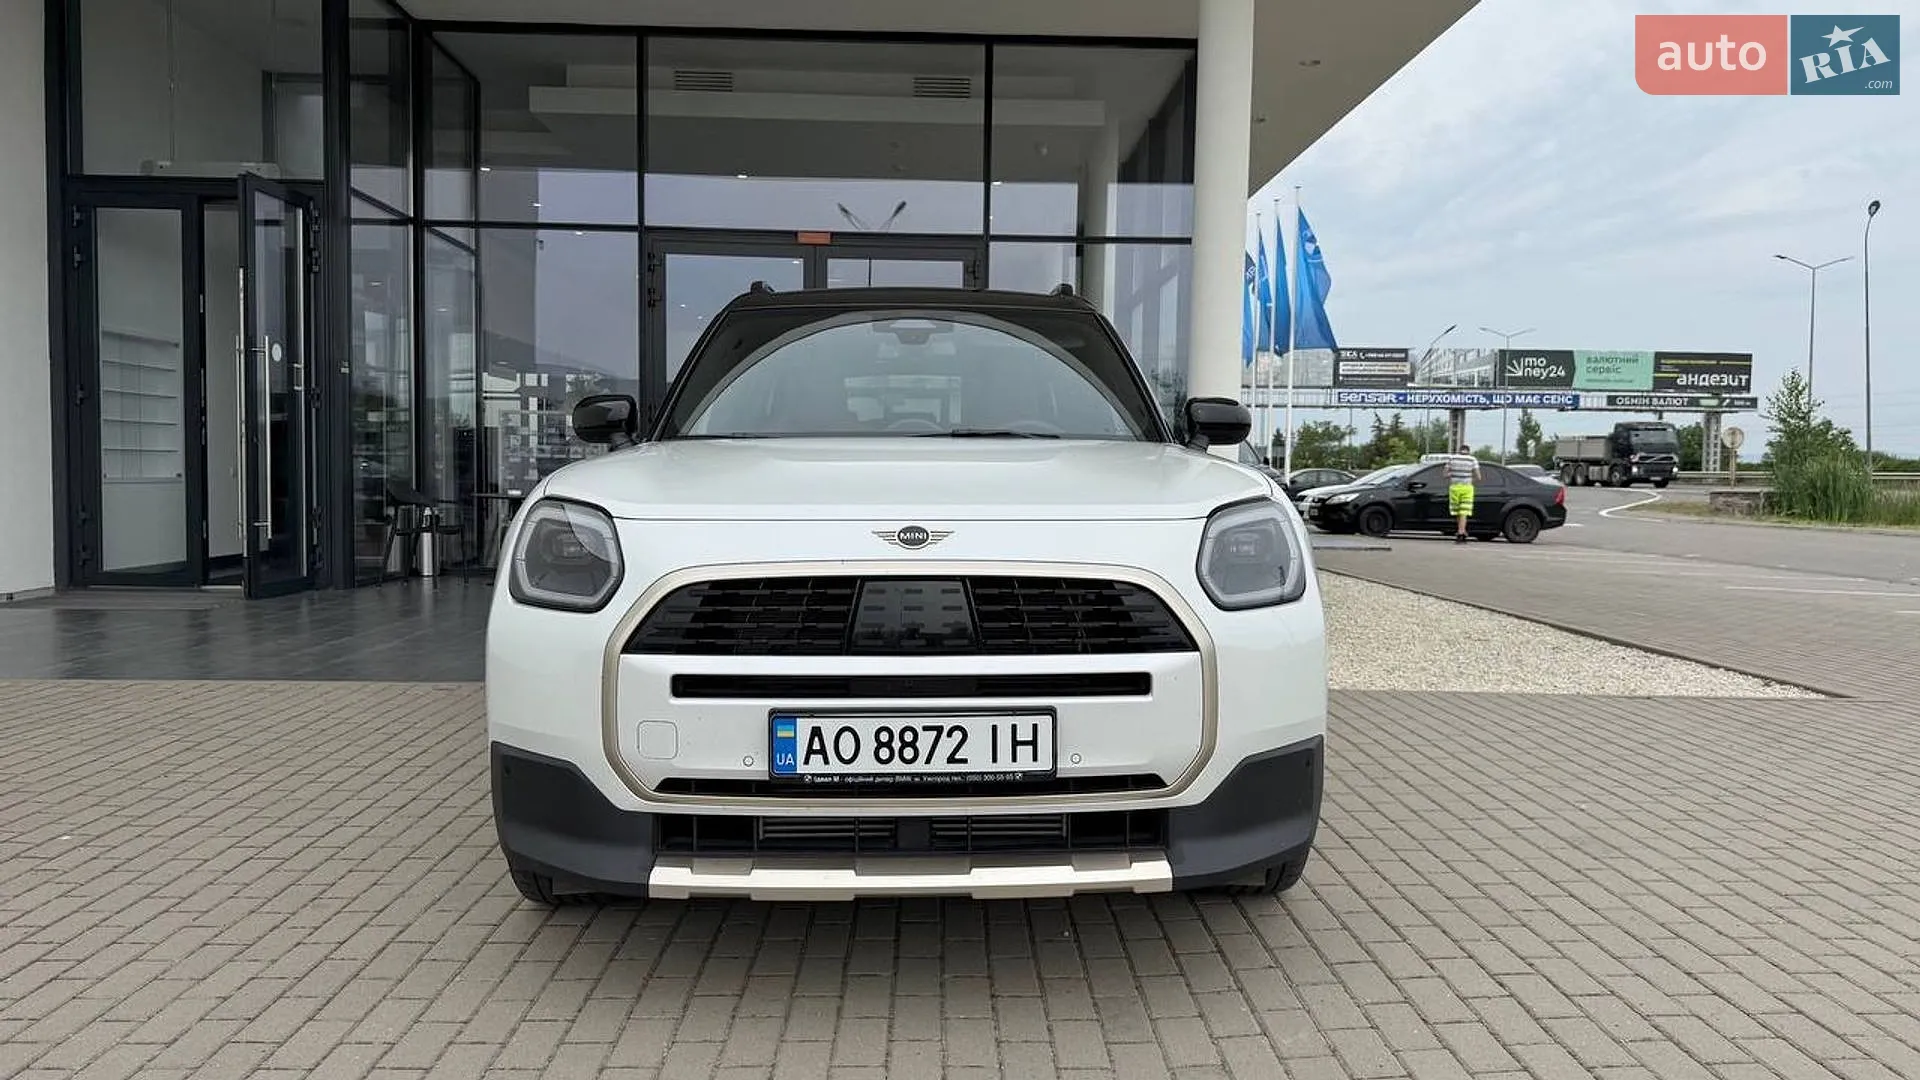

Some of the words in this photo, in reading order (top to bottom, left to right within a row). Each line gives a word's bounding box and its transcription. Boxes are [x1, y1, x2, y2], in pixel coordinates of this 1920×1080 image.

[1677, 373, 1749, 387] андезит
[1652, 398, 1688, 406] ВАЛЮТ
[900, 532, 927, 541] MINI
[803, 725, 861, 766] AO
[873, 725, 969, 765] 8872
[991, 723, 1039, 763] IH
[776, 752, 795, 766] UA
